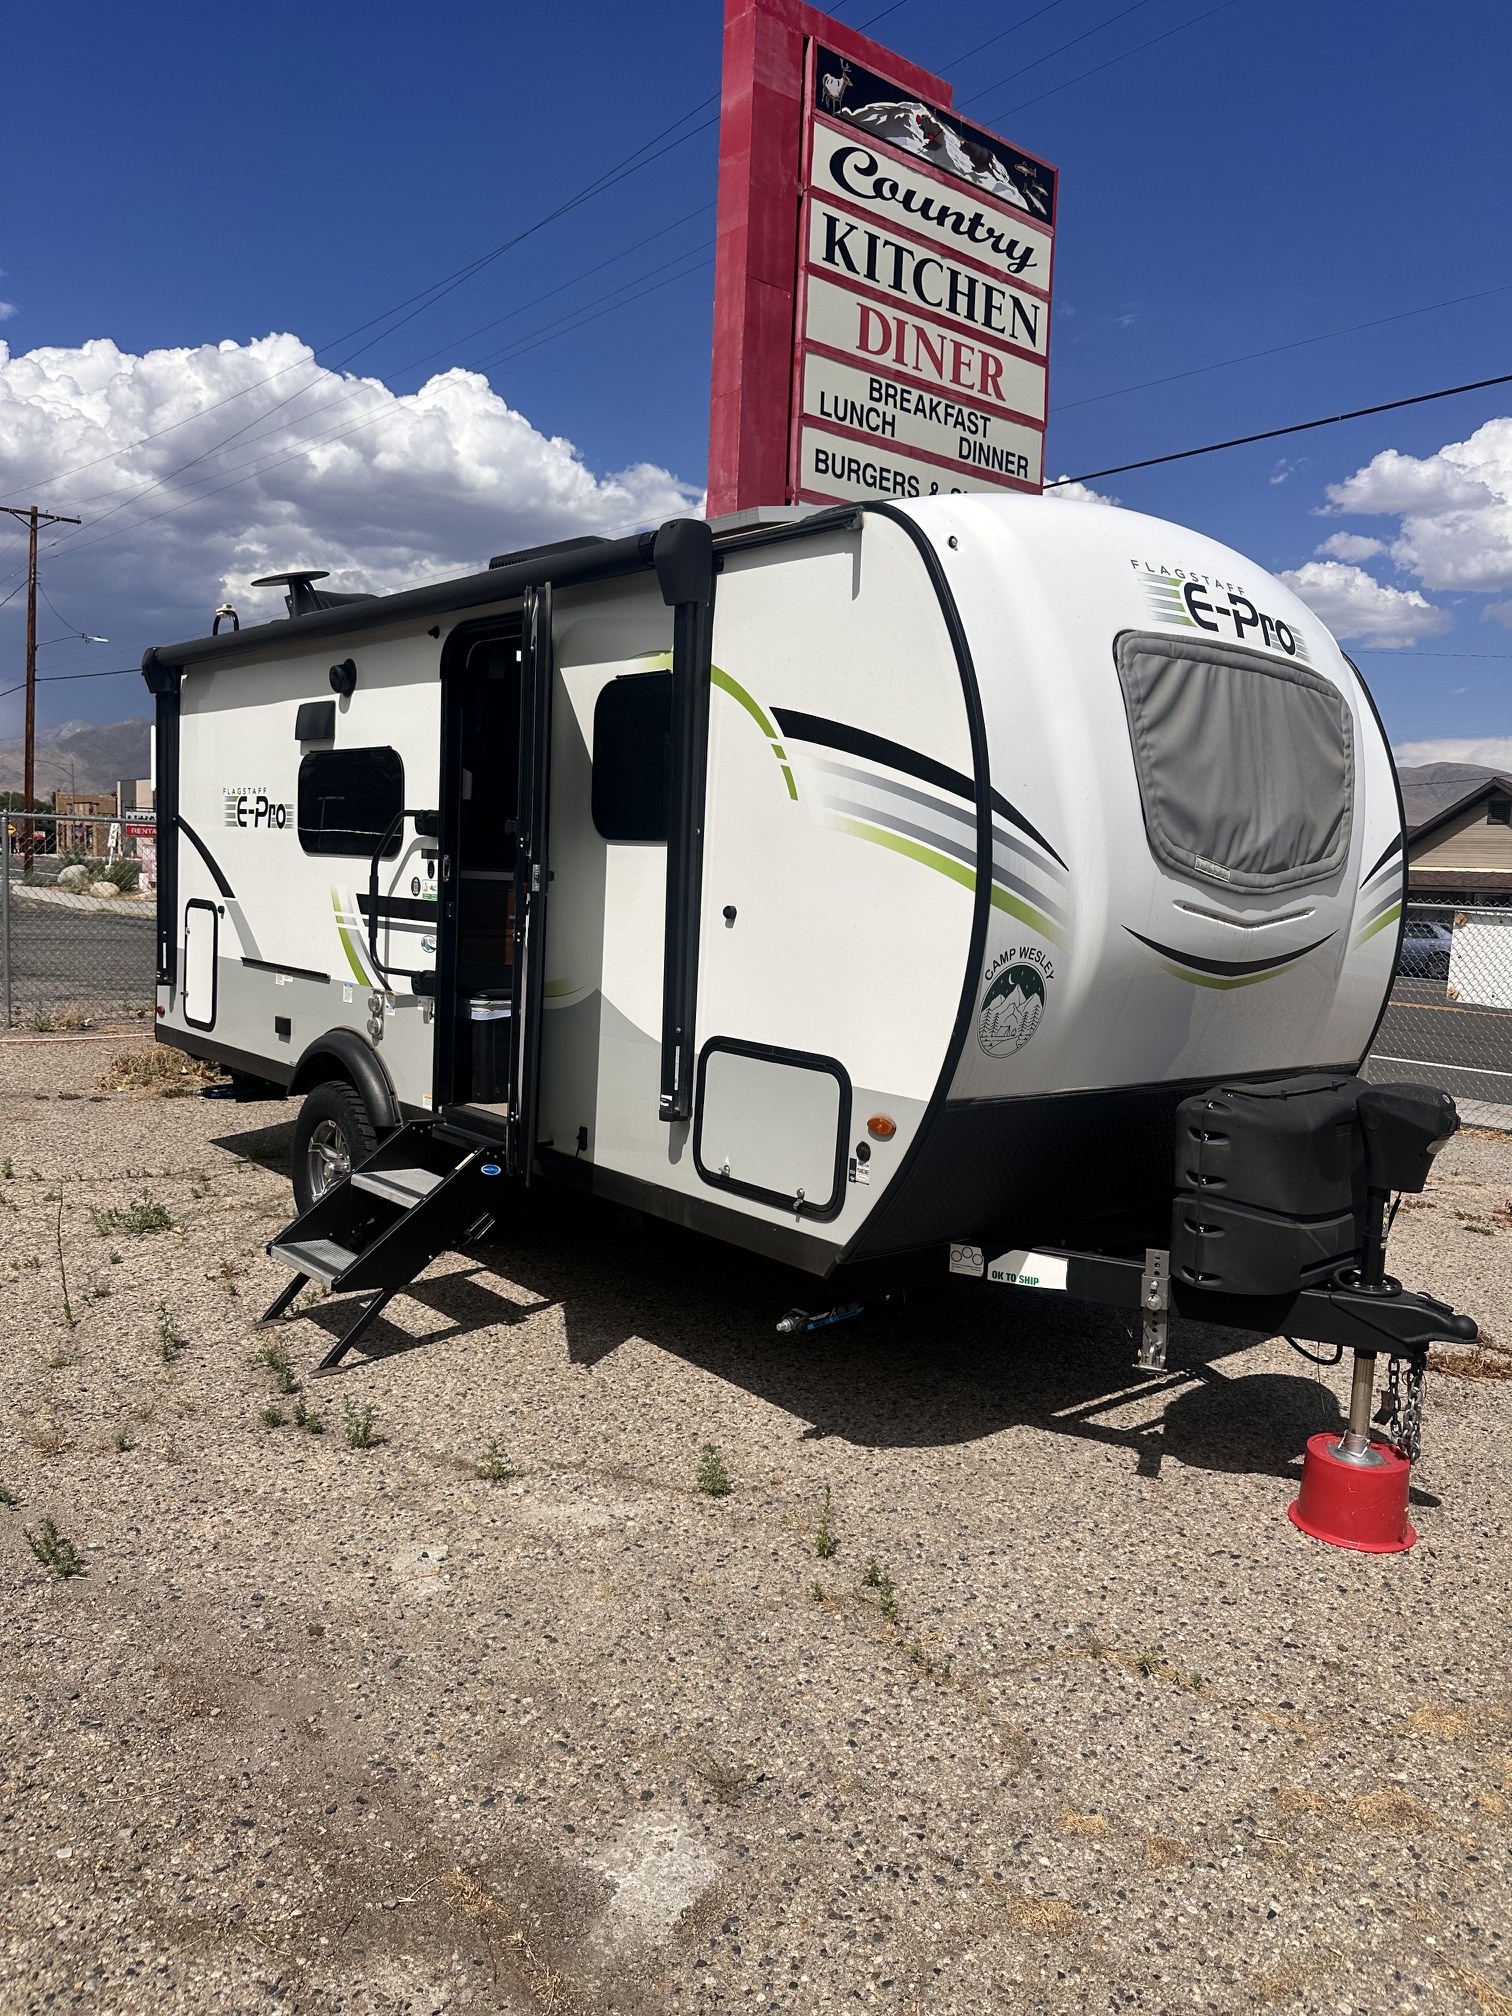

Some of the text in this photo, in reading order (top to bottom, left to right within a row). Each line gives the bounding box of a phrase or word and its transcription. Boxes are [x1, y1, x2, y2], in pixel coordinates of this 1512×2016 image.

[829, 146, 1038, 274] Country
[822, 213, 1040, 347] KITCHEN
[856, 302, 1006, 402] DINER
[820, 391, 896, 439] LUNCH
[869, 377, 991, 439] BREAKFAST
[815, 448, 939, 498] BURGERS &
[959, 436, 1029, 479] DINNER
[1130, 559, 1245, 595] FLAGSTAFF
[1184, 582, 1296, 656] E-Pro
[222, 787, 267, 795] FLAGSTAFF
[237, 796, 286, 829] E-Pro
[985, 946, 1055, 981] CAMP WESLEY
[991, 1270, 1040, 1286] OK TO SHIP
